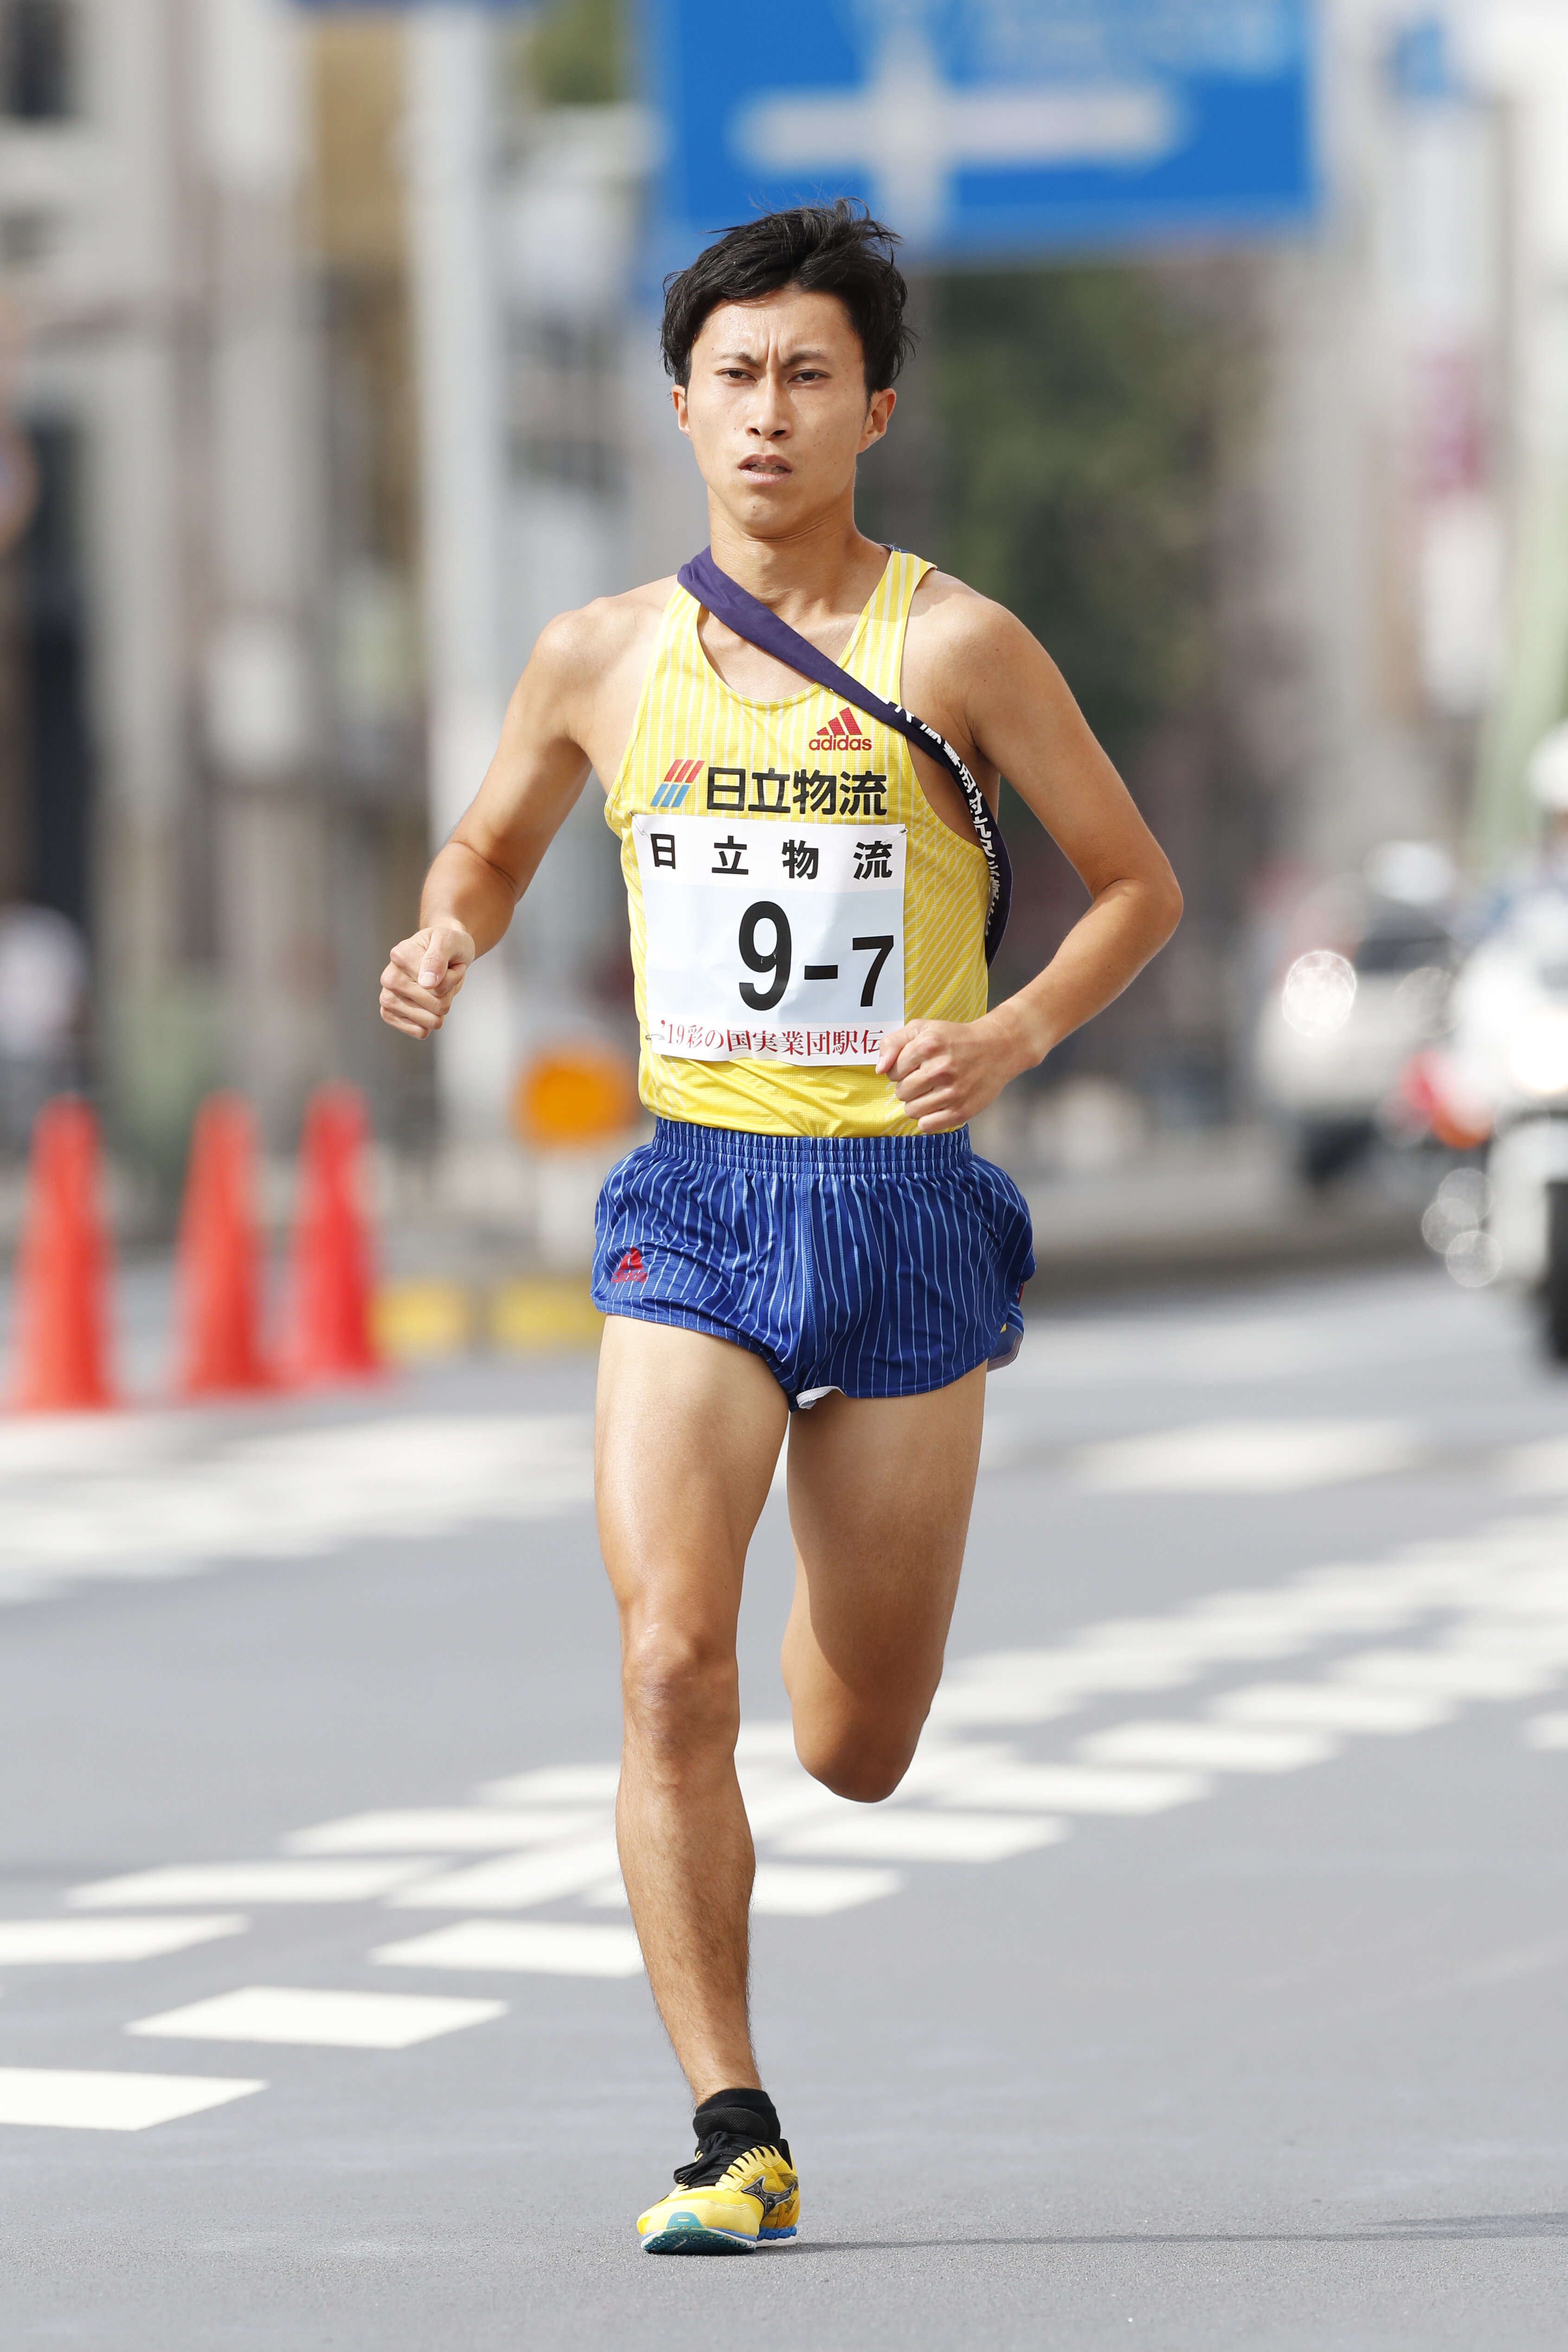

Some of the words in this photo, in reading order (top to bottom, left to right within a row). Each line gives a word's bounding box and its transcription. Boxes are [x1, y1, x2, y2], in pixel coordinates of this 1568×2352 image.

[809, 735, 872, 751] adidas
[707, 766, 887, 816] 日立物流
[650, 833, 893, 880] 日立物流
[739, 900, 894, 1011] 9-7
[610, 1268, 648, 1284] didas
